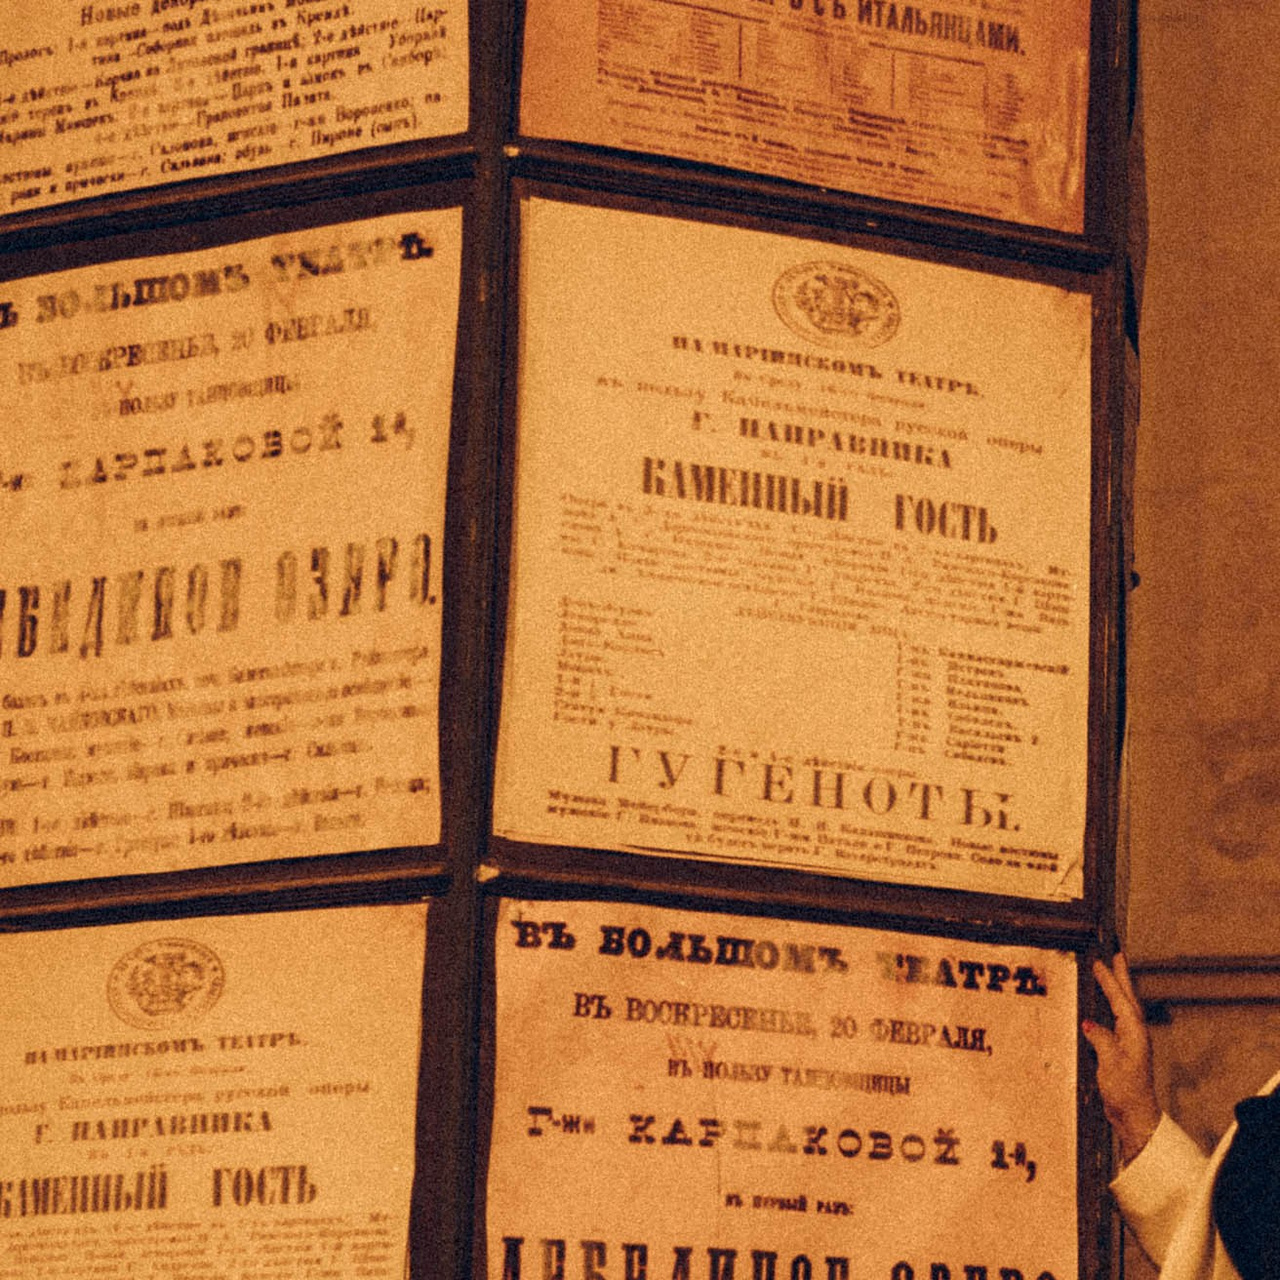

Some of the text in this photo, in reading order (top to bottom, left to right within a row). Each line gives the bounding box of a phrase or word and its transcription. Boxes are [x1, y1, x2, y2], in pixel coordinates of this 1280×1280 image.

[672, 335, 702, 352] НА
[691, 409, 951, 468] Г. НАПРАВНИКА
[641, 456, 848, 521] КАМЕННЫЙ
[894, 493, 997, 543] ГОСТЬ
[0, 556, 241, 660] БЕДИНОЕ
[608, 744, 1020, 829] ГУГЕНОТЫ.
[513, 916, 576, 950] ВЪ
[598, 925, 848, 973] БОЛЬШОМЪ
[573, 992, 994, 1057] ВЪ ВОСКРЕСЕНЬЕ, 20 ФЕВРАЛЯ,
[25, 1050, 46, 1064] НА
[667, 1058, 692, 1077] ВЪ
[702, 1059, 771, 1081] ПОЛЬЗУ
[35, 1110, 271, 1143] Г. НАПРАВНИКА
[526, 1105, 595, 1137] Г-жи
[627, 1113, 960, 1166] КАРПАКОВОЙ
[212, 1164, 317, 1207] ГОСТЬ
